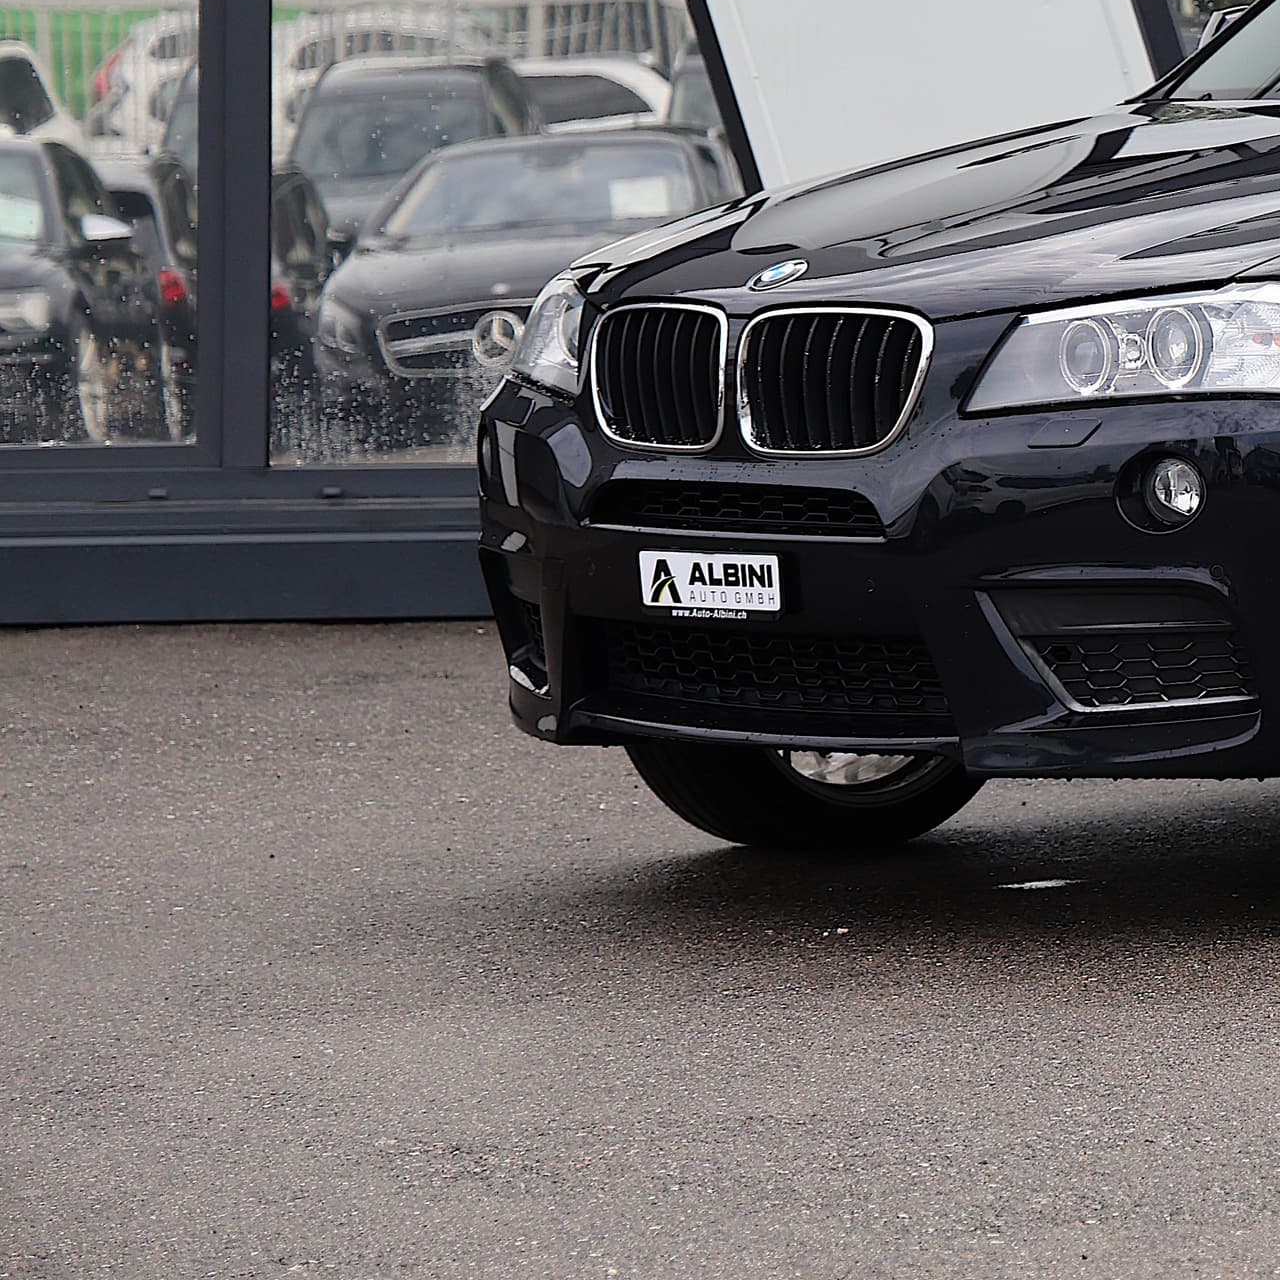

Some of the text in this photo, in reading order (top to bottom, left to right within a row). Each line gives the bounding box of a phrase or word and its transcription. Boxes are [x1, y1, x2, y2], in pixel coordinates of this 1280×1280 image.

[688, 562, 773, 588] ALBINI
[690, 590, 775, 605] AUTO GMBH
